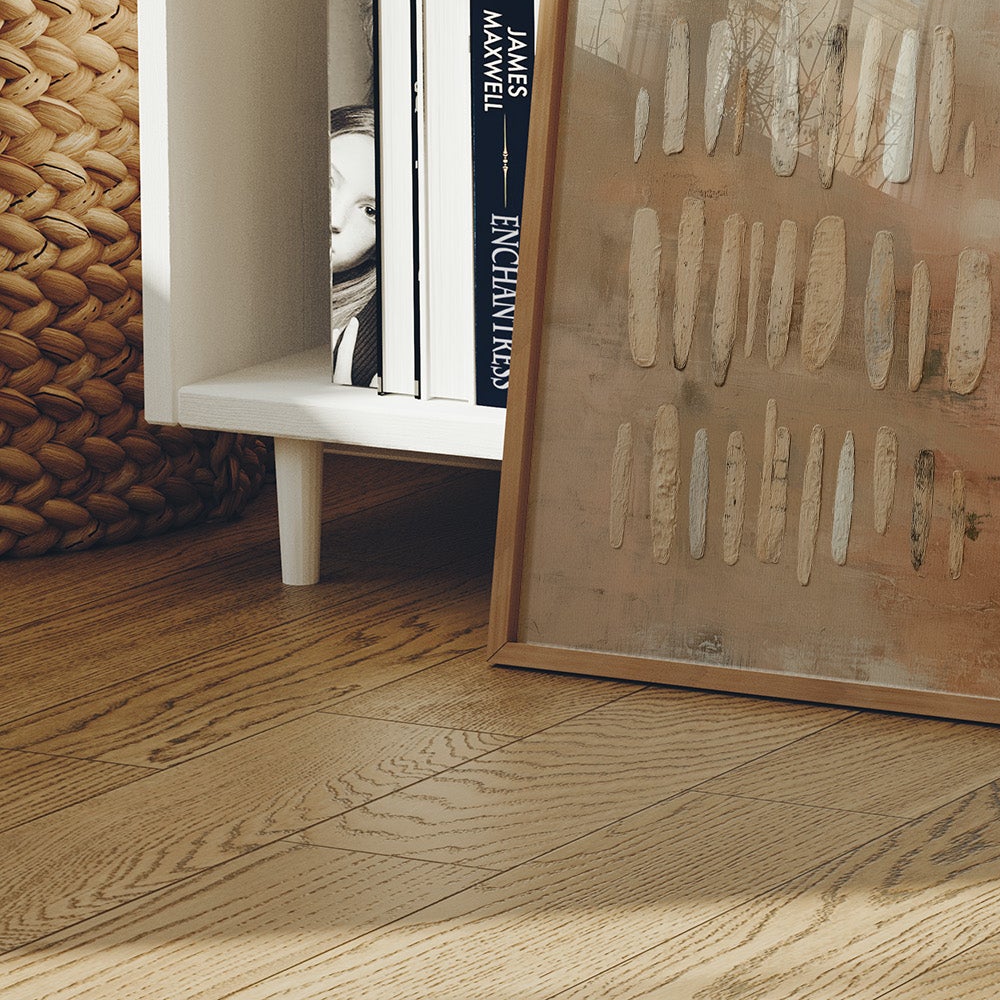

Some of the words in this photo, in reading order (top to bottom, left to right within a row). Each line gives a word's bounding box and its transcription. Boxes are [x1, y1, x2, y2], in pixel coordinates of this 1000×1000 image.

[483, 9, 503, 112] MAXWELL
[507, 26, 528, 97] JAMES
[490, 213, 520, 390] ENCHANTRESS
